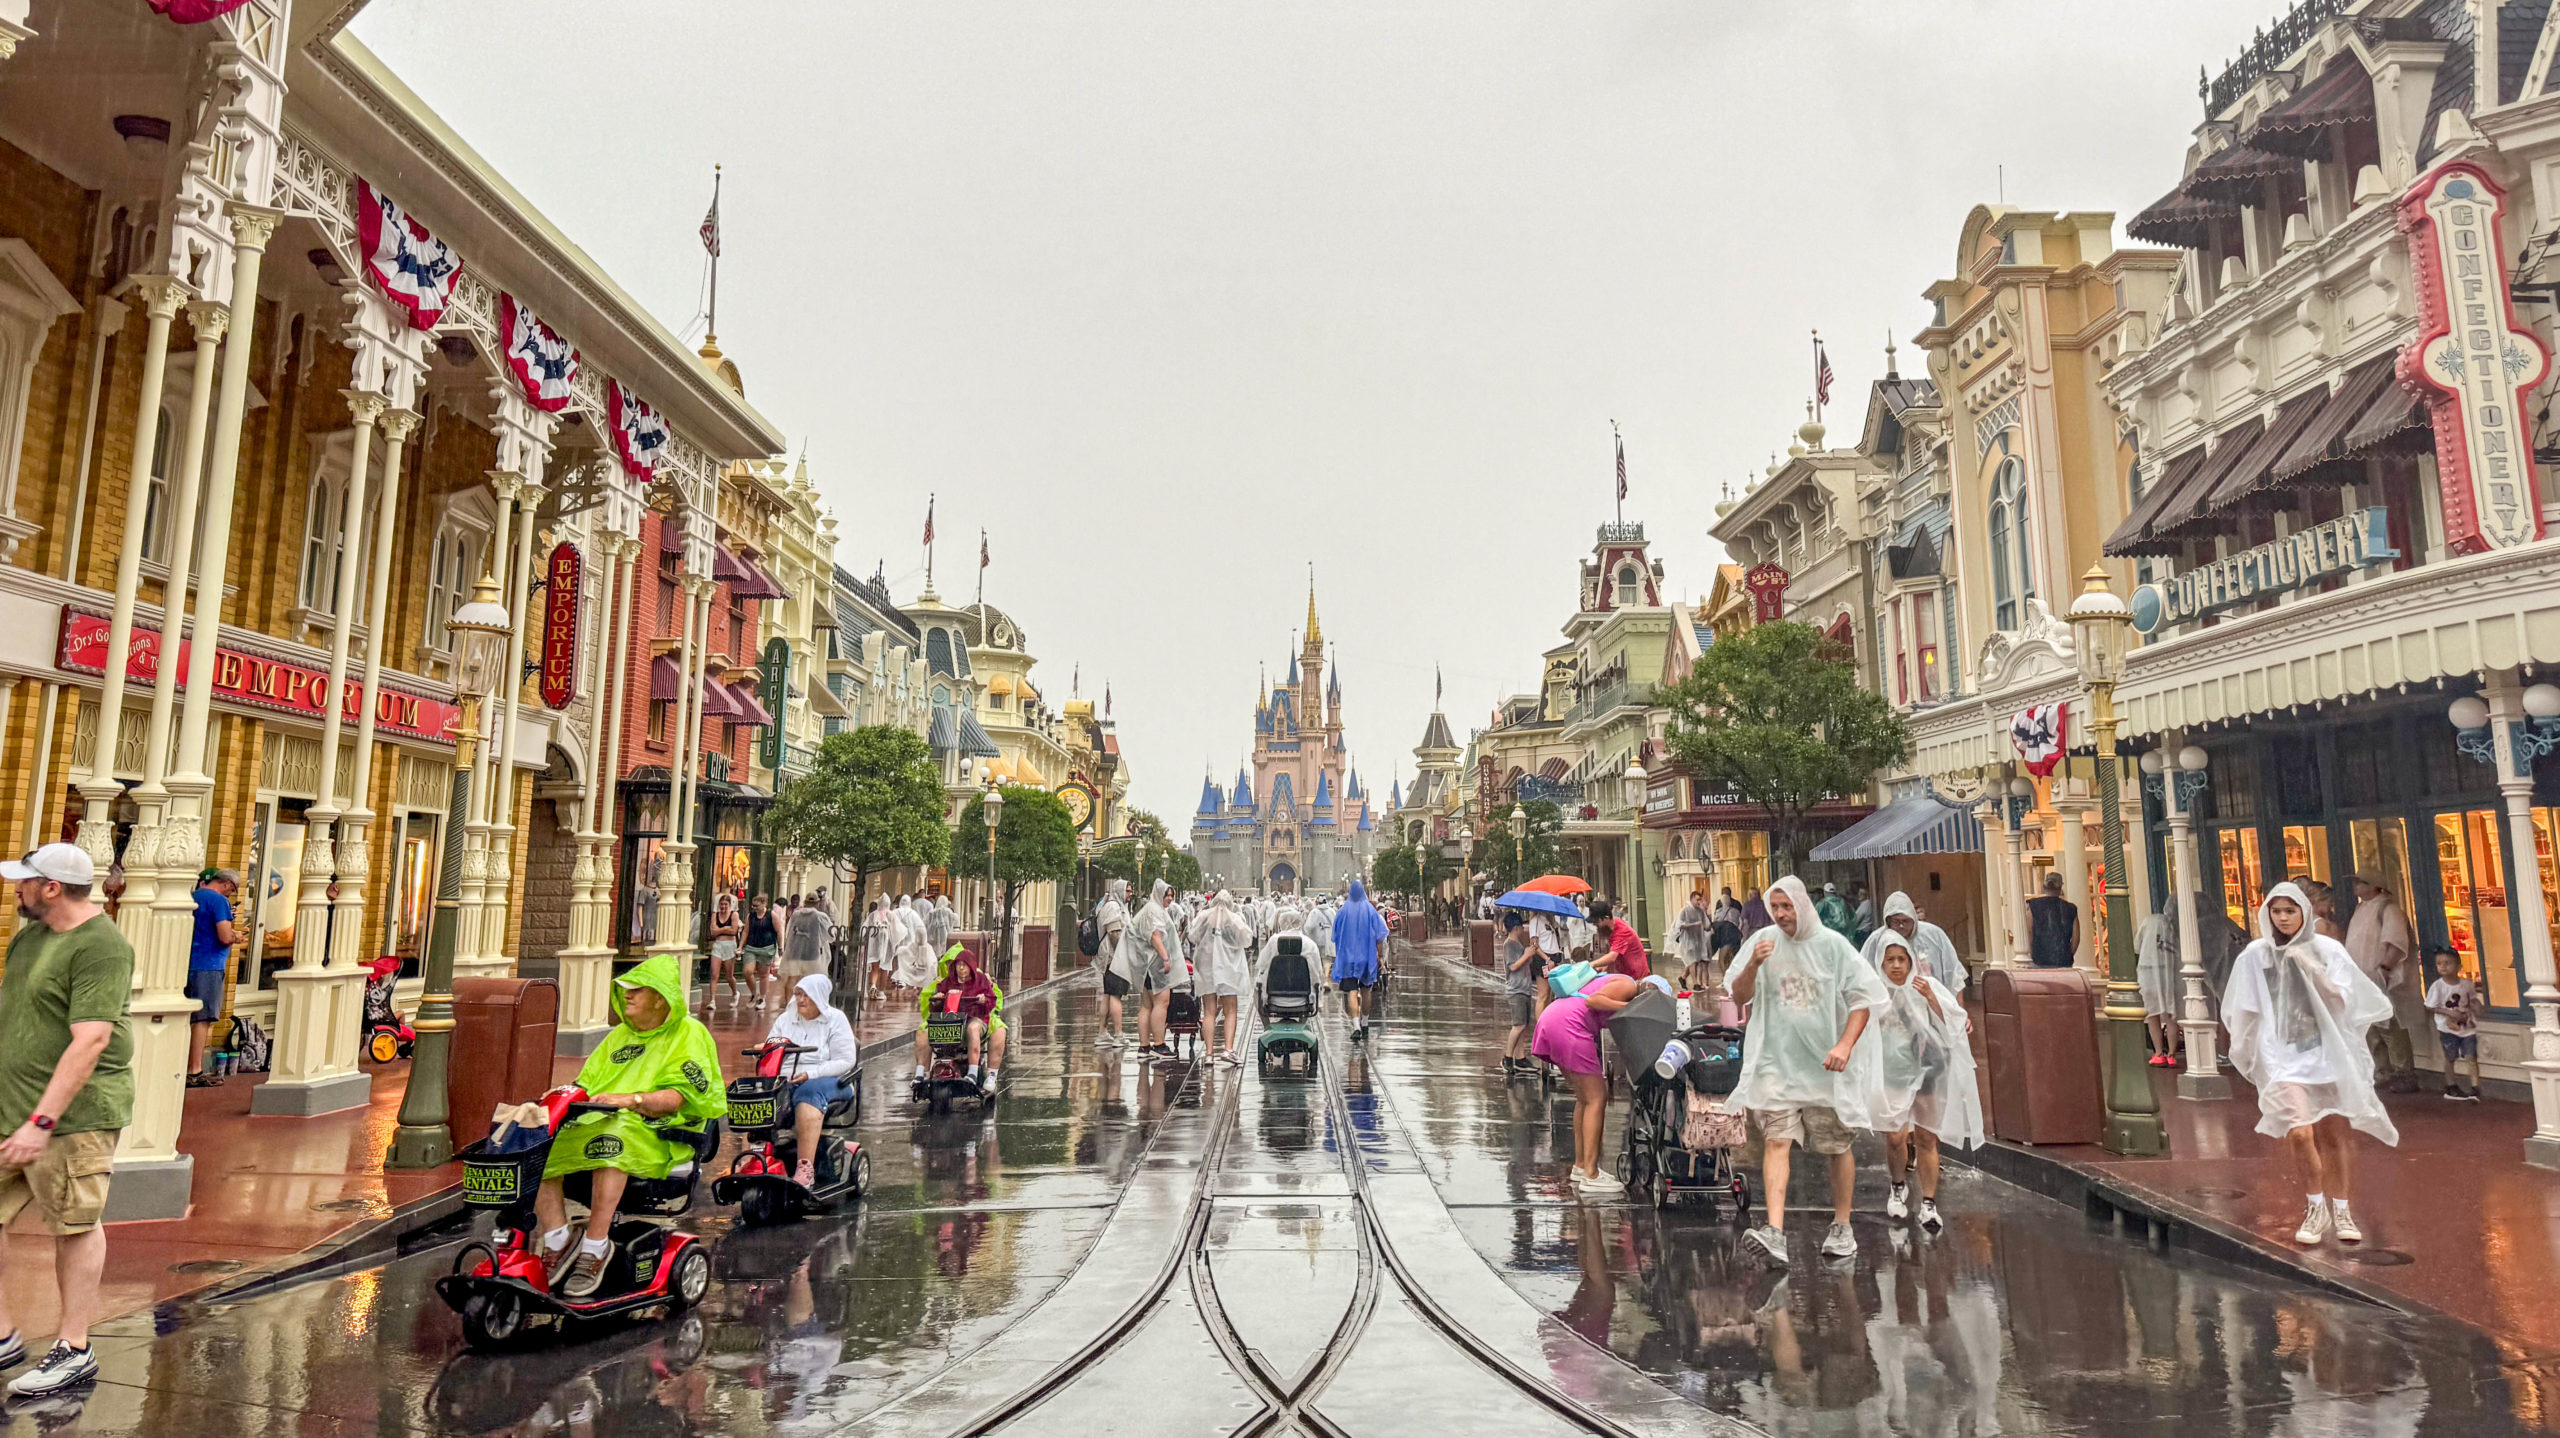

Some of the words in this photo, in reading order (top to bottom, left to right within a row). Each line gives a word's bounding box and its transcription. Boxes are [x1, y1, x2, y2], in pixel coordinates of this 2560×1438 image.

[2450, 204, 2519, 532] CONFECTIONERY
[2162, 507, 2372, 623] CONFECTIONERY
[1751, 571, 1783, 583] MAIN
[545, 559, 574, 690] EMPORIUM
[73, 632, 93, 652] Dry
[129, 638, 151, 656] tions
[138, 651, 146, 664] &
[217, 652, 422, 728] EMPORUM
[765, 648, 780, 757] ARCADE
[710, 752, 730, 782] GIFTS
[1701, 793, 1740, 805] MICKEY
[929, 1030, 961, 1038] RENTALS
[727, 1109, 773, 1119] RENTALS
[749, 1102, 773, 1111] VISTA
[485, 1168, 514, 1177] VISTA
